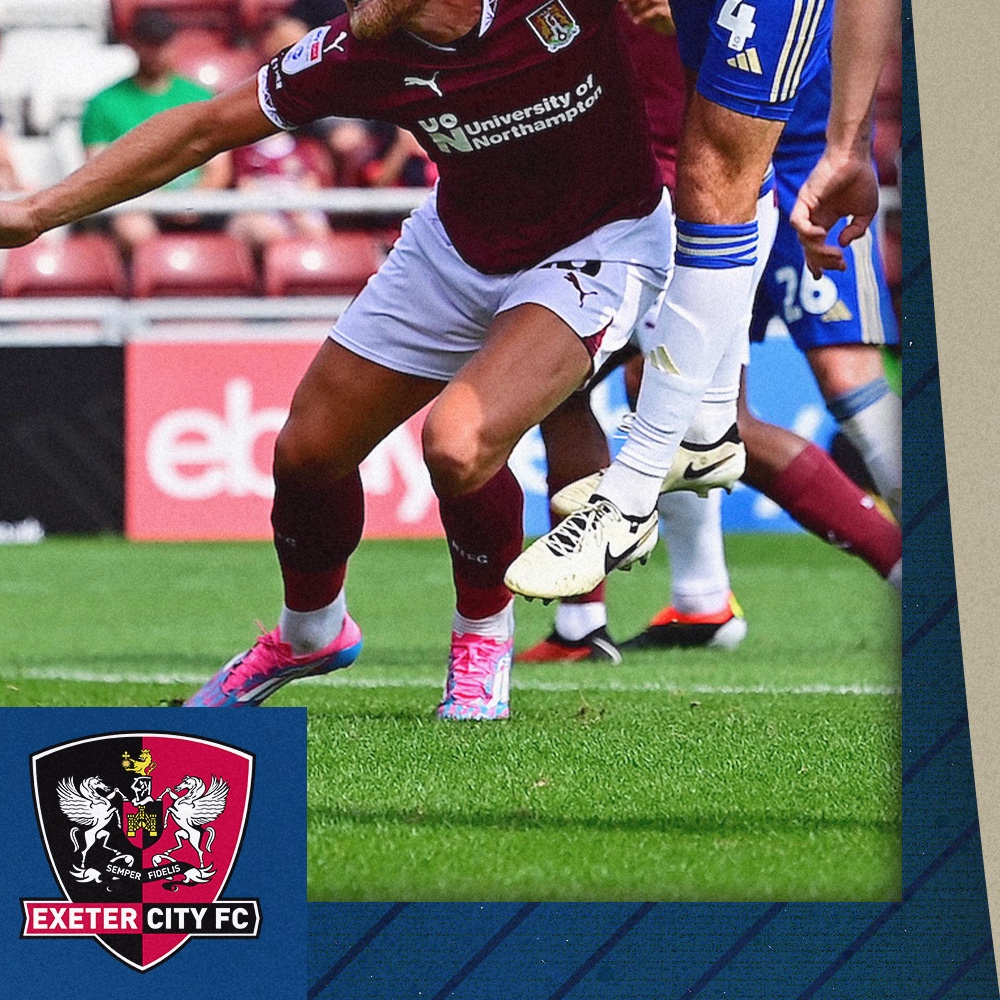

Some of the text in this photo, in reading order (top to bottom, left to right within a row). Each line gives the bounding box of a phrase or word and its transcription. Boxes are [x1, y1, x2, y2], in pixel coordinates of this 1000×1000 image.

[465, 73, 594, 136] University of
[472, 85, 603, 150] Northampton
[774, 258, 839, 325] 26
